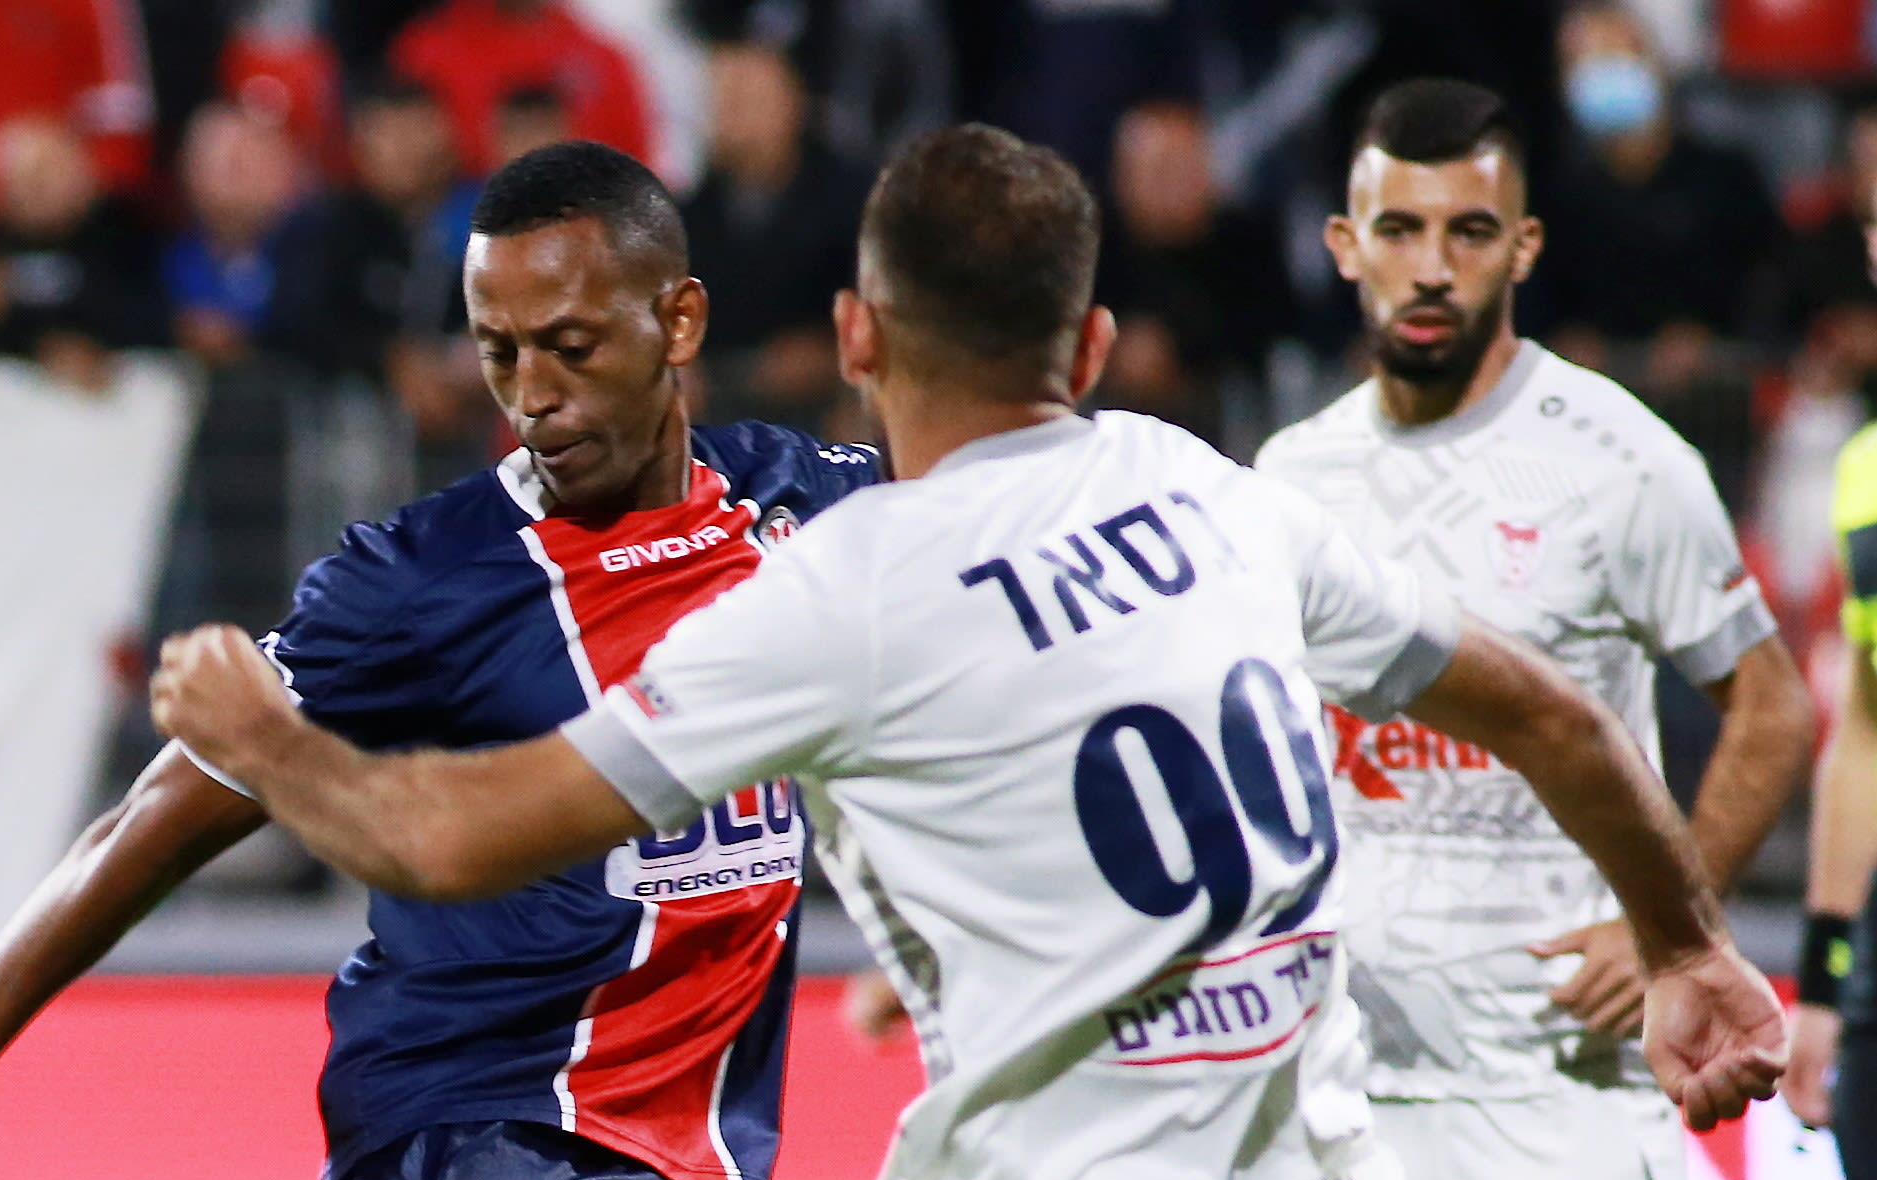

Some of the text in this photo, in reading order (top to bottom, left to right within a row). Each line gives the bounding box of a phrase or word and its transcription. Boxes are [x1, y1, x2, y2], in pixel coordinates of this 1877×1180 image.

[598, 525, 730, 573] GIVOVA
[1074, 658, 1339, 958] 99
[635, 868, 742, 896] ENERGY
